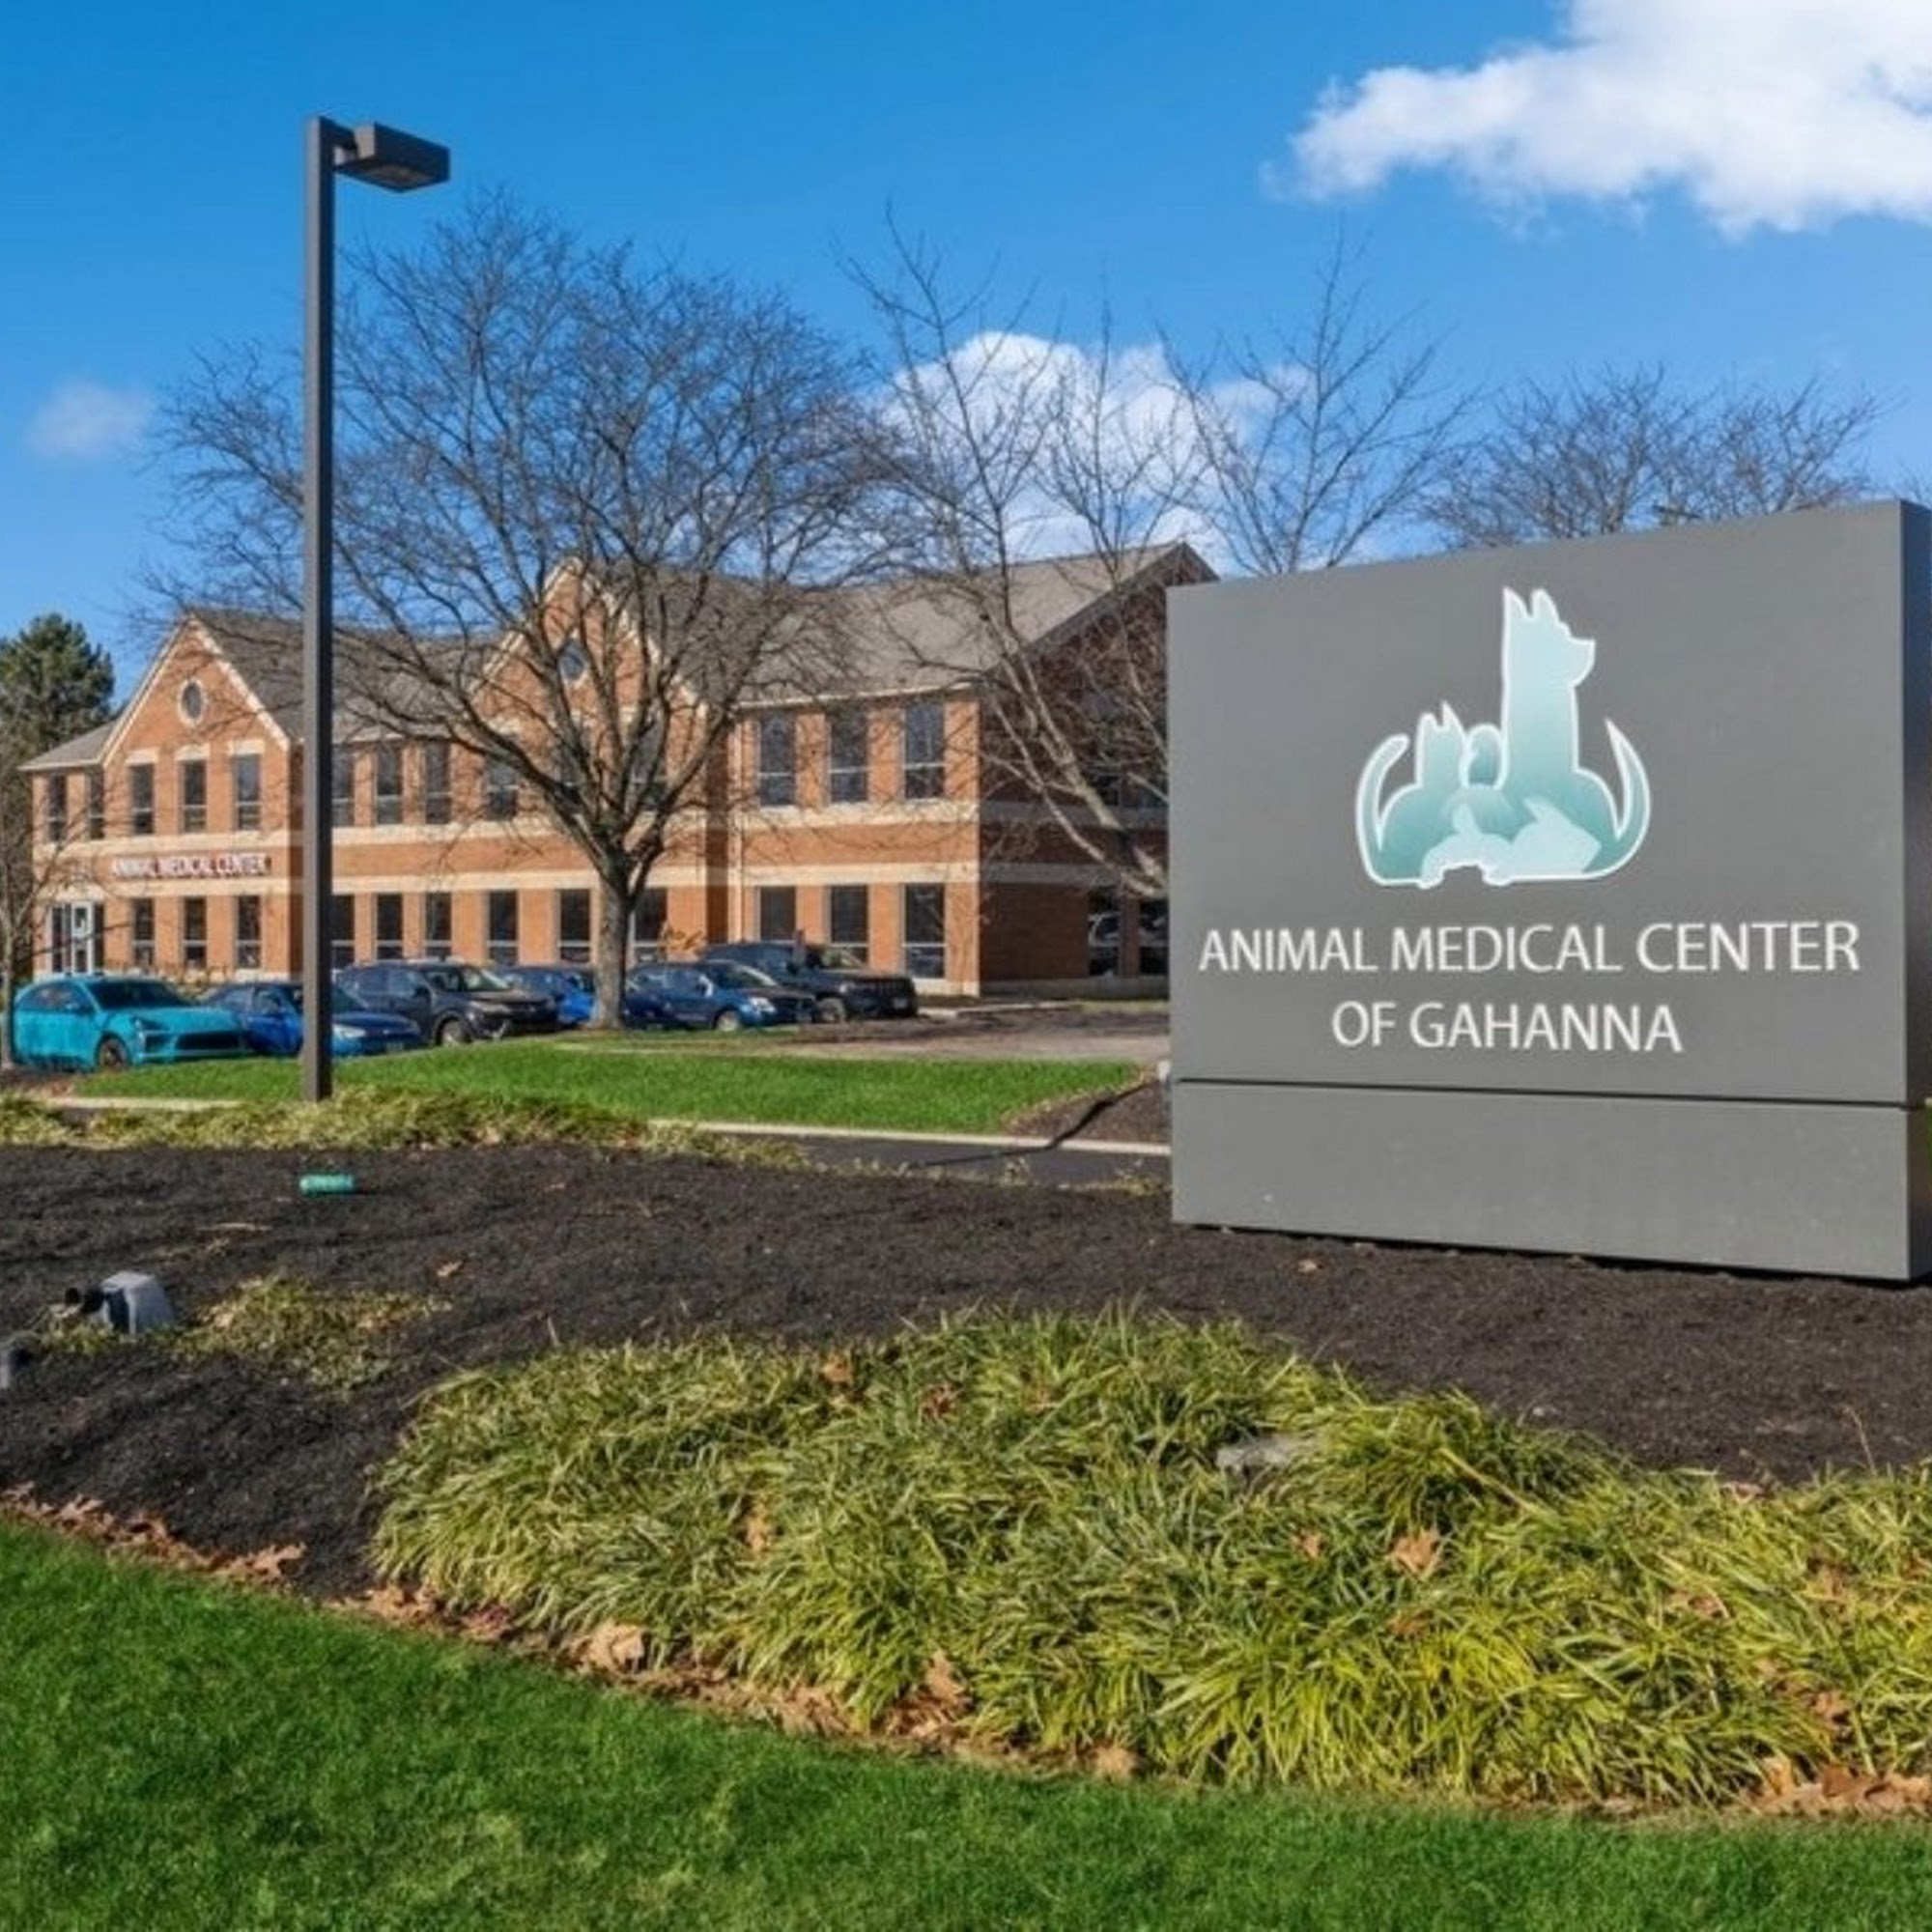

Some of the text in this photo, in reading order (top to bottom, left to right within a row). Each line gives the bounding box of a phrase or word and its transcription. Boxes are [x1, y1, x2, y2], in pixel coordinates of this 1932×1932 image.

[1198, 919, 1861, 974] ANIMAL MEDICAL CENTER
[1330, 1000, 1685, 1054] OF GAHANNA
